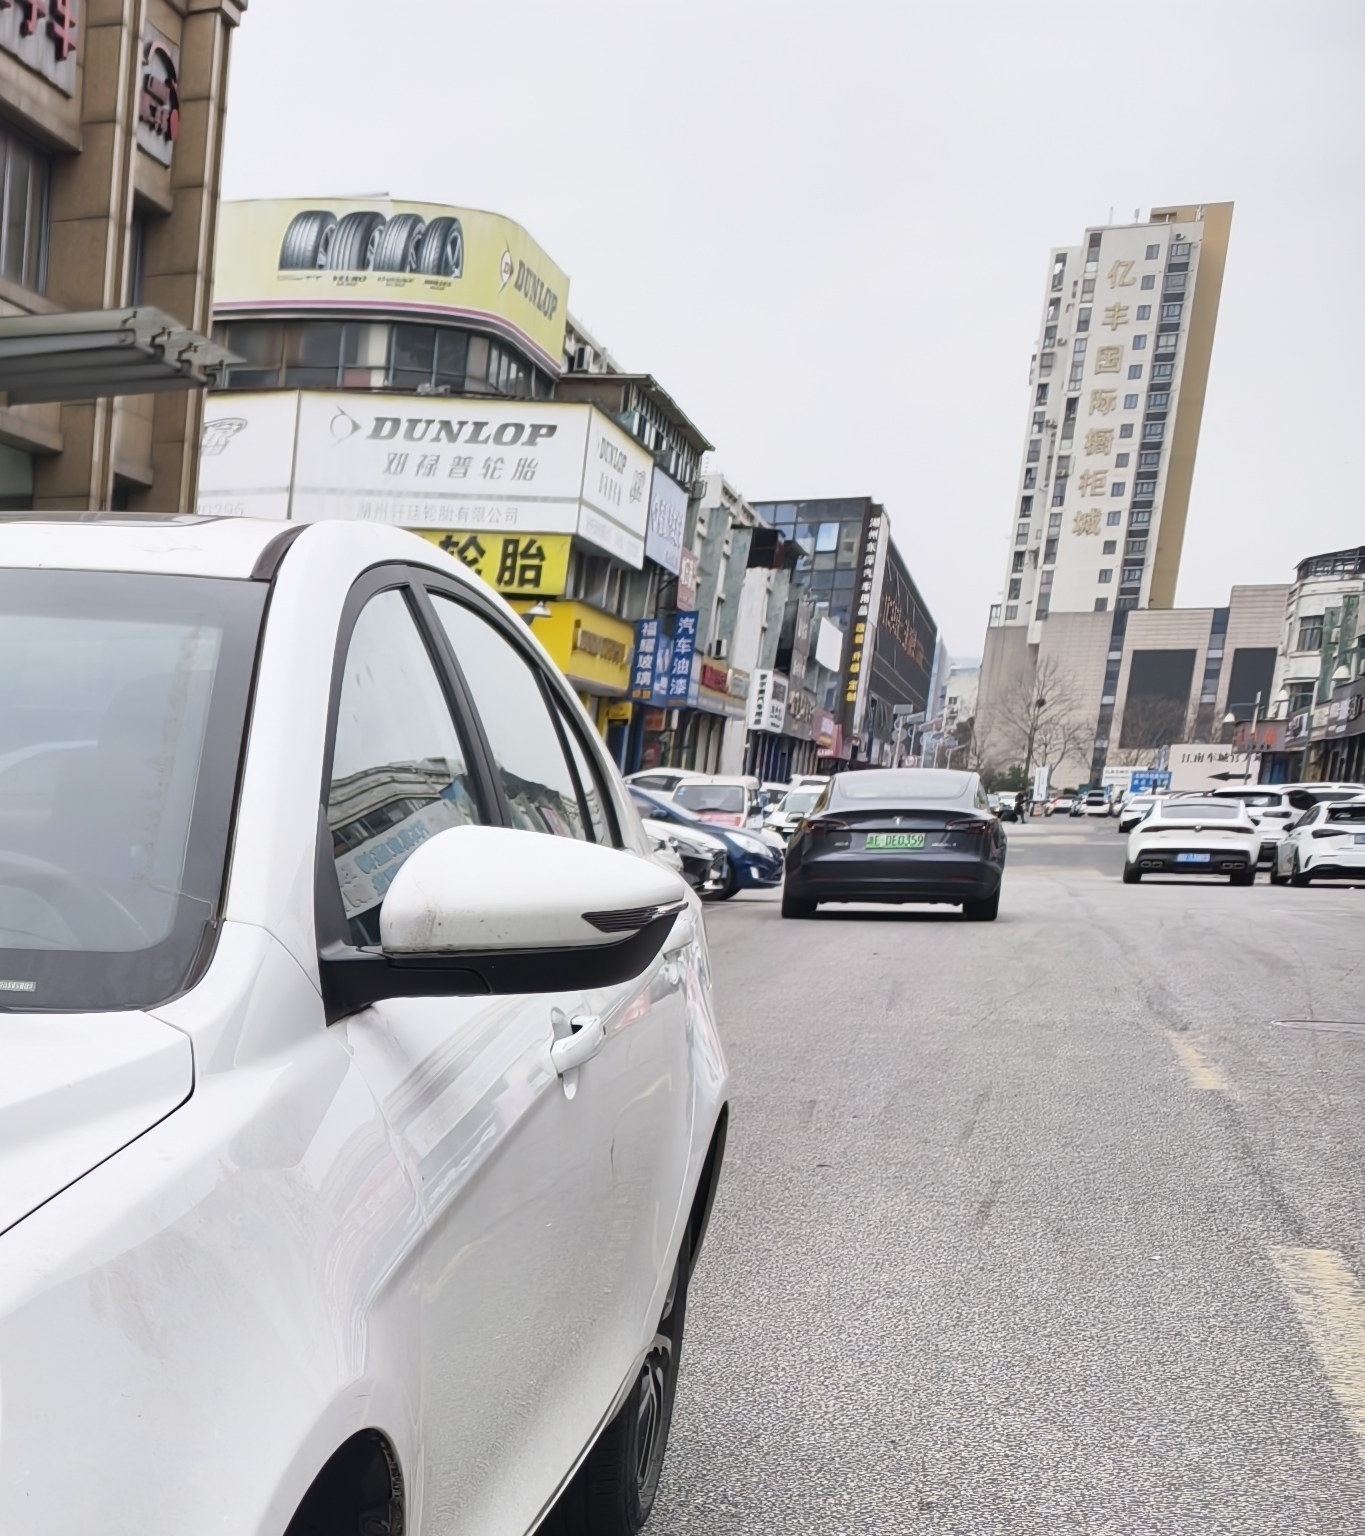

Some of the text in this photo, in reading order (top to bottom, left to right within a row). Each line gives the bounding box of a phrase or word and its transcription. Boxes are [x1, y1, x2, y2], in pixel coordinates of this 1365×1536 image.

[514, 259, 558, 321] DUNLOP
[1072, 260, 1136, 537] 亿丰国际橱柜城
[366, 416, 558, 447] DUNLOP
[381, 451, 539, 482] 邓禄普轮胎
[636, 621, 657, 686] 福耀玻璃
[669, 617, 694, 695] 汽车油漆
